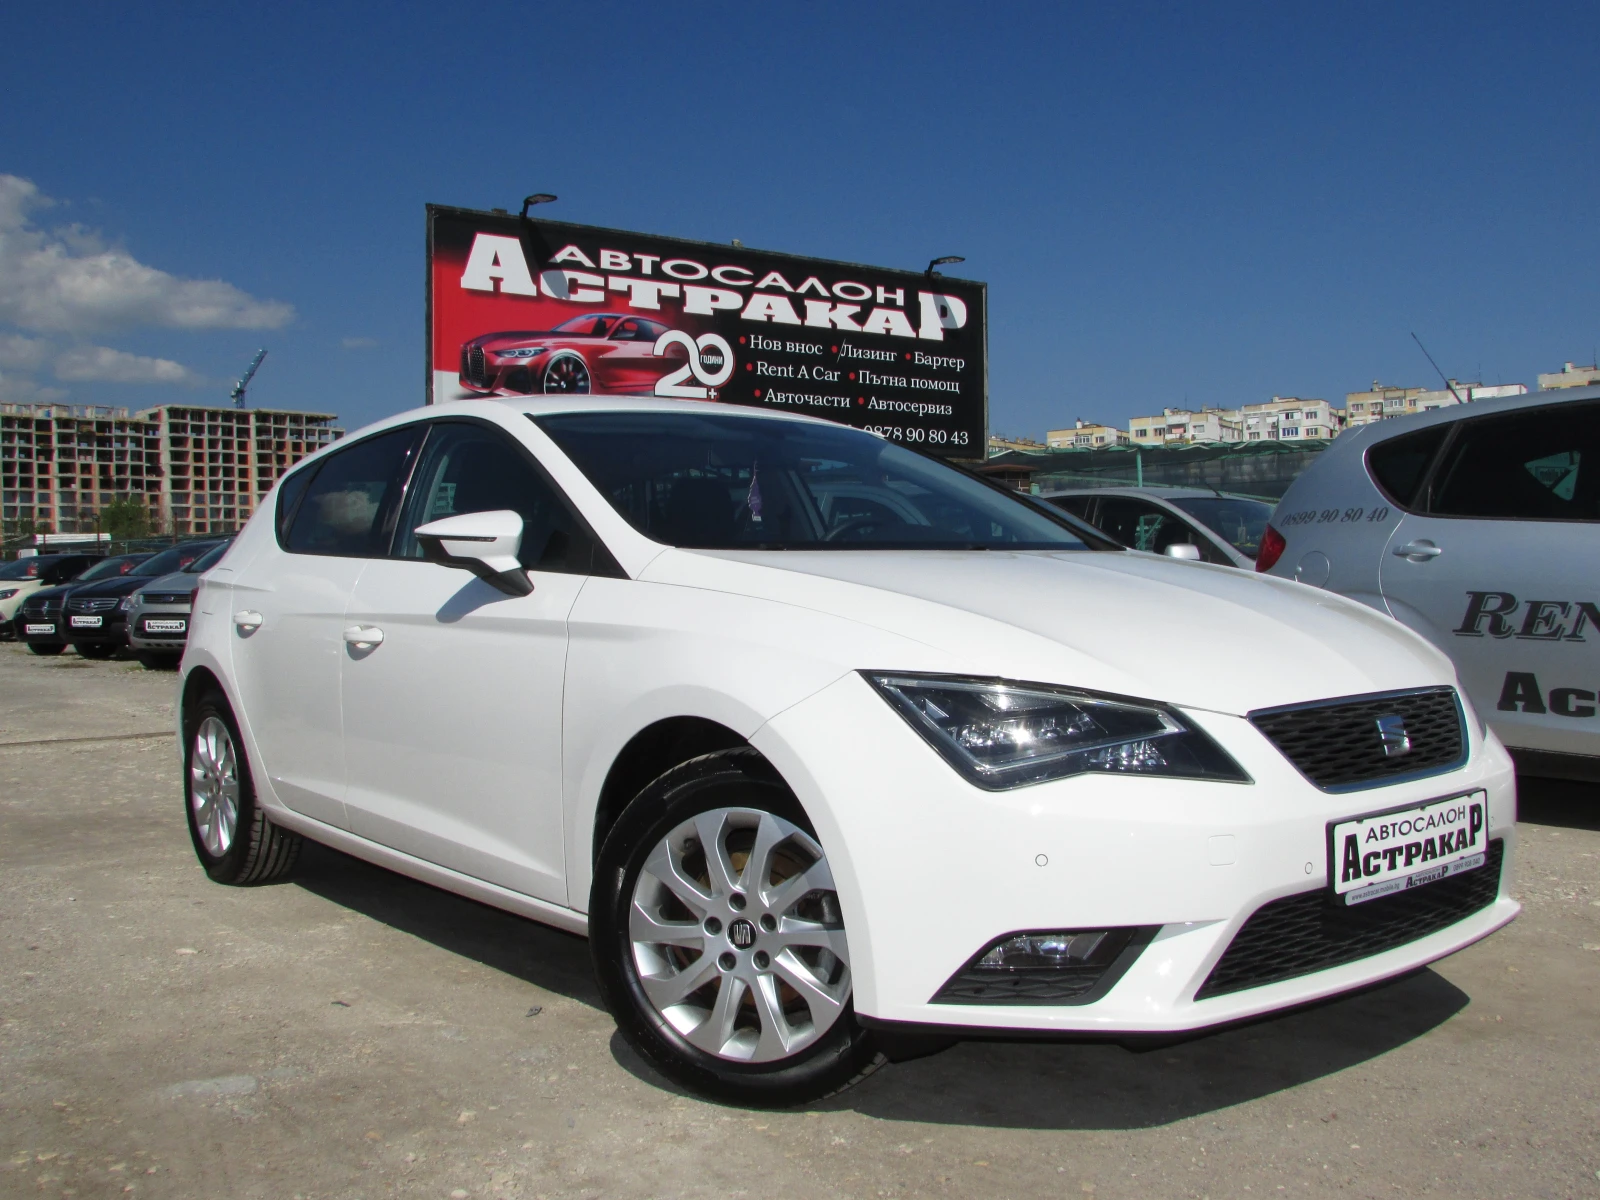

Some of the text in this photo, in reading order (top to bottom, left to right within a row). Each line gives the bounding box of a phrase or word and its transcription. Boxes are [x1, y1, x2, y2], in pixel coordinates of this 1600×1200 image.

[549, 244, 905, 306] АВТОСАЛОН
[749, 334, 823, 355] Нов внос
[840, 343, 898, 362] Лизинг
[756, 361, 841, 382] Rent A Car
[914, 352, 965, 372] Бартер
[858, 371, 960, 394] Пътна помощ
[764, 388, 851, 408] Авточасти
[867, 397, 953, 416] Автосервиз
[906, 427, 925, 442] 90
[928, 429, 947, 443] 80
[950, 431, 969, 445] 43
[1281, 506, 1389, 526] 0899 90 80 40
[1365, 804, 1466, 844] АВТОСАЛОН
